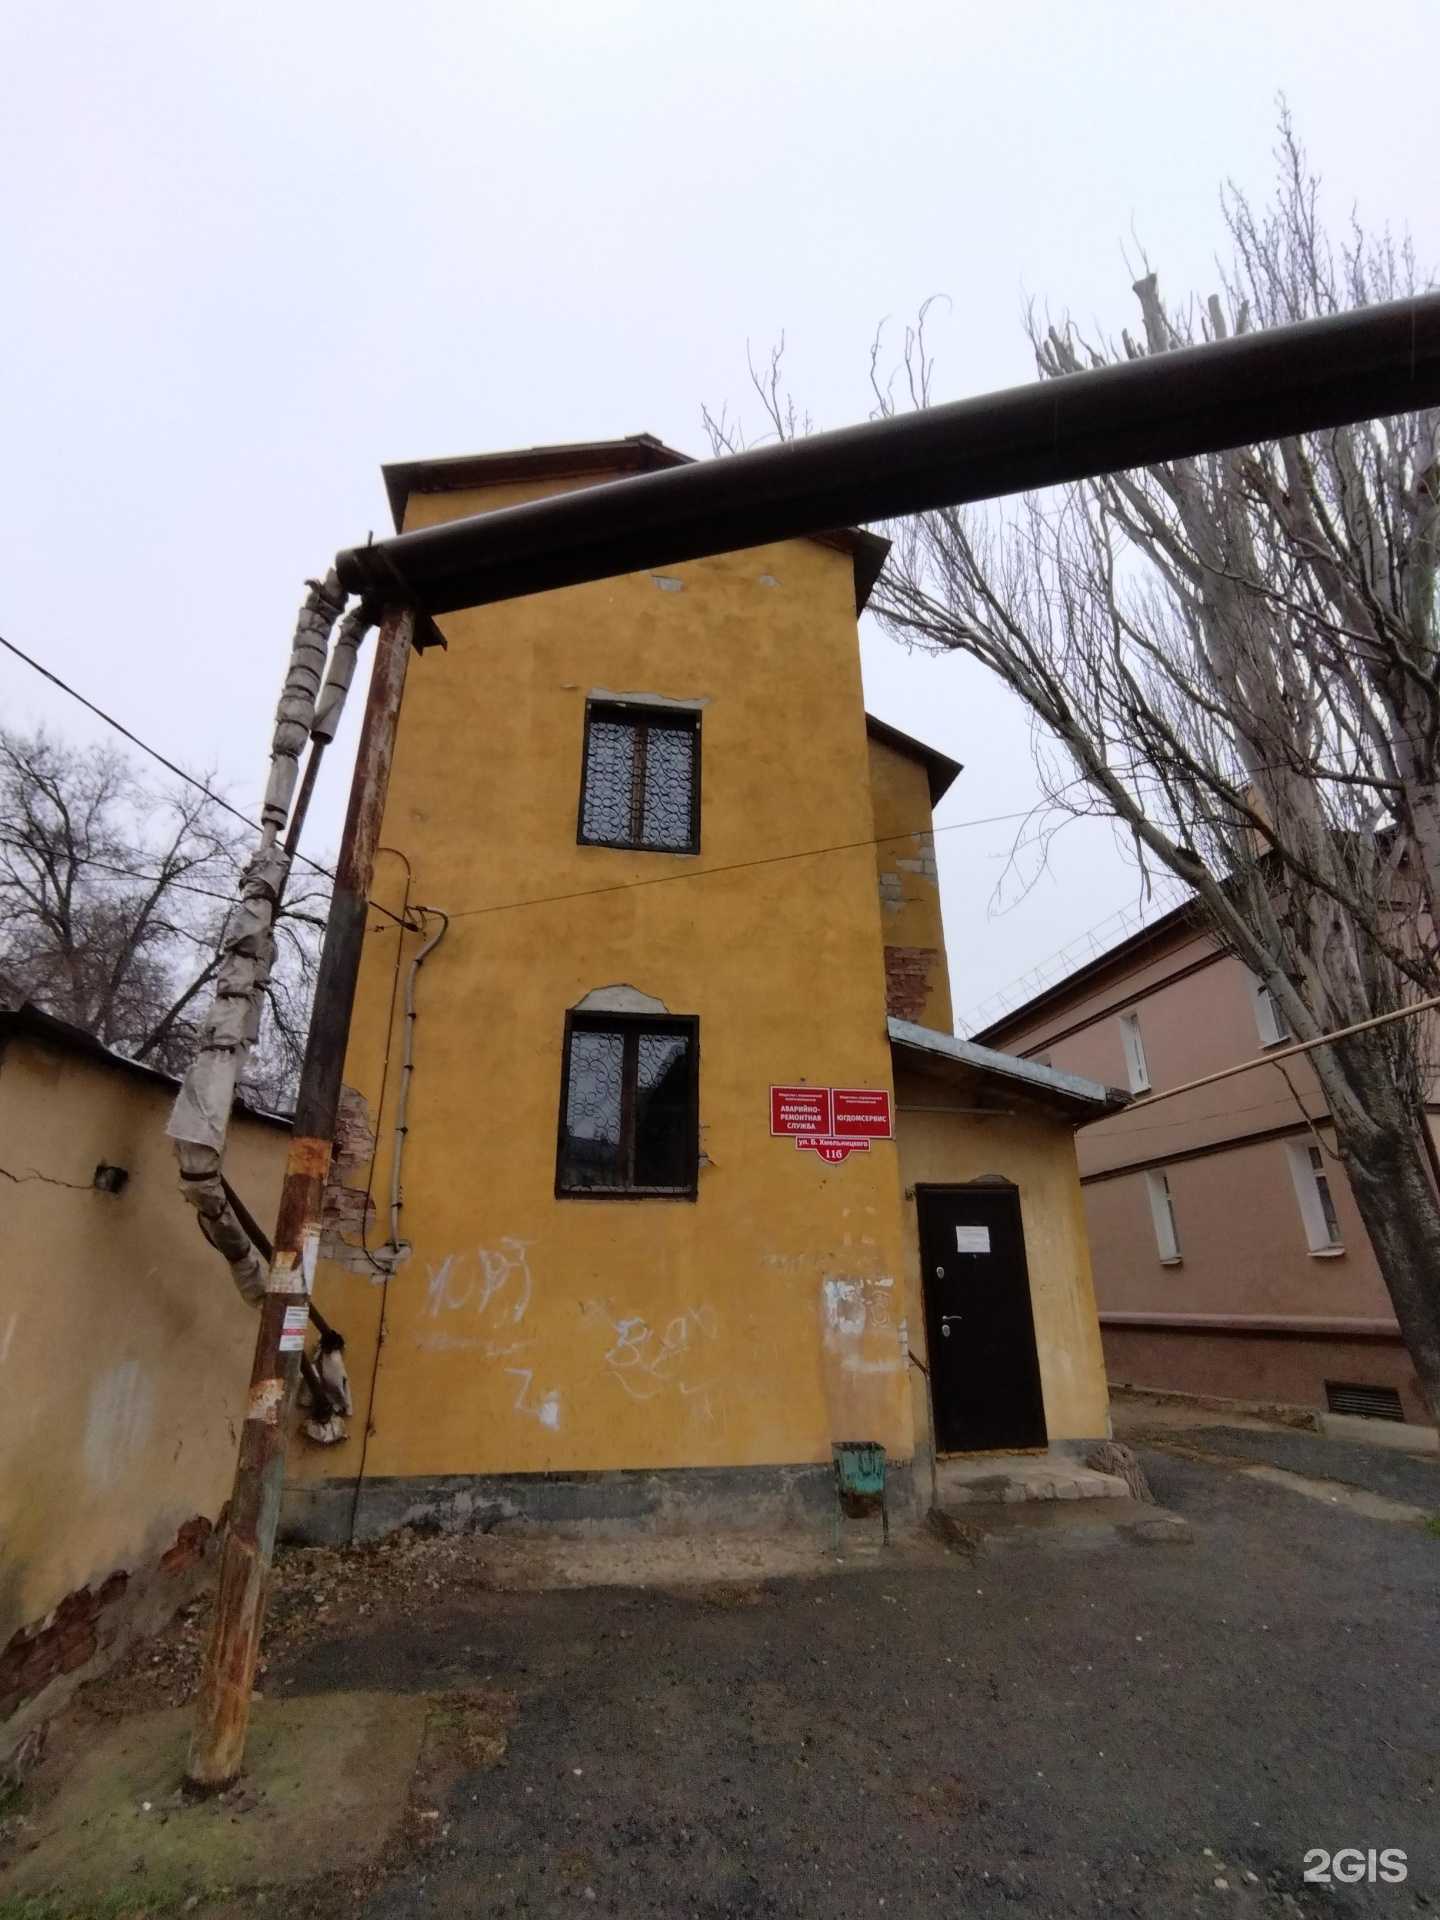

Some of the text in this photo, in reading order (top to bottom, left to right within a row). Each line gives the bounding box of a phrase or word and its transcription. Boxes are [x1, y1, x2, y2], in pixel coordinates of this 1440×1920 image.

[780, 1105, 821, 1113] АВАРИЙНО-
[780, 1113, 822, 1121] РЕМОНТНАЯ
[798, 1138, 809, 1146] ул.
[820, 1139, 868, 1147] Хмельницкого
